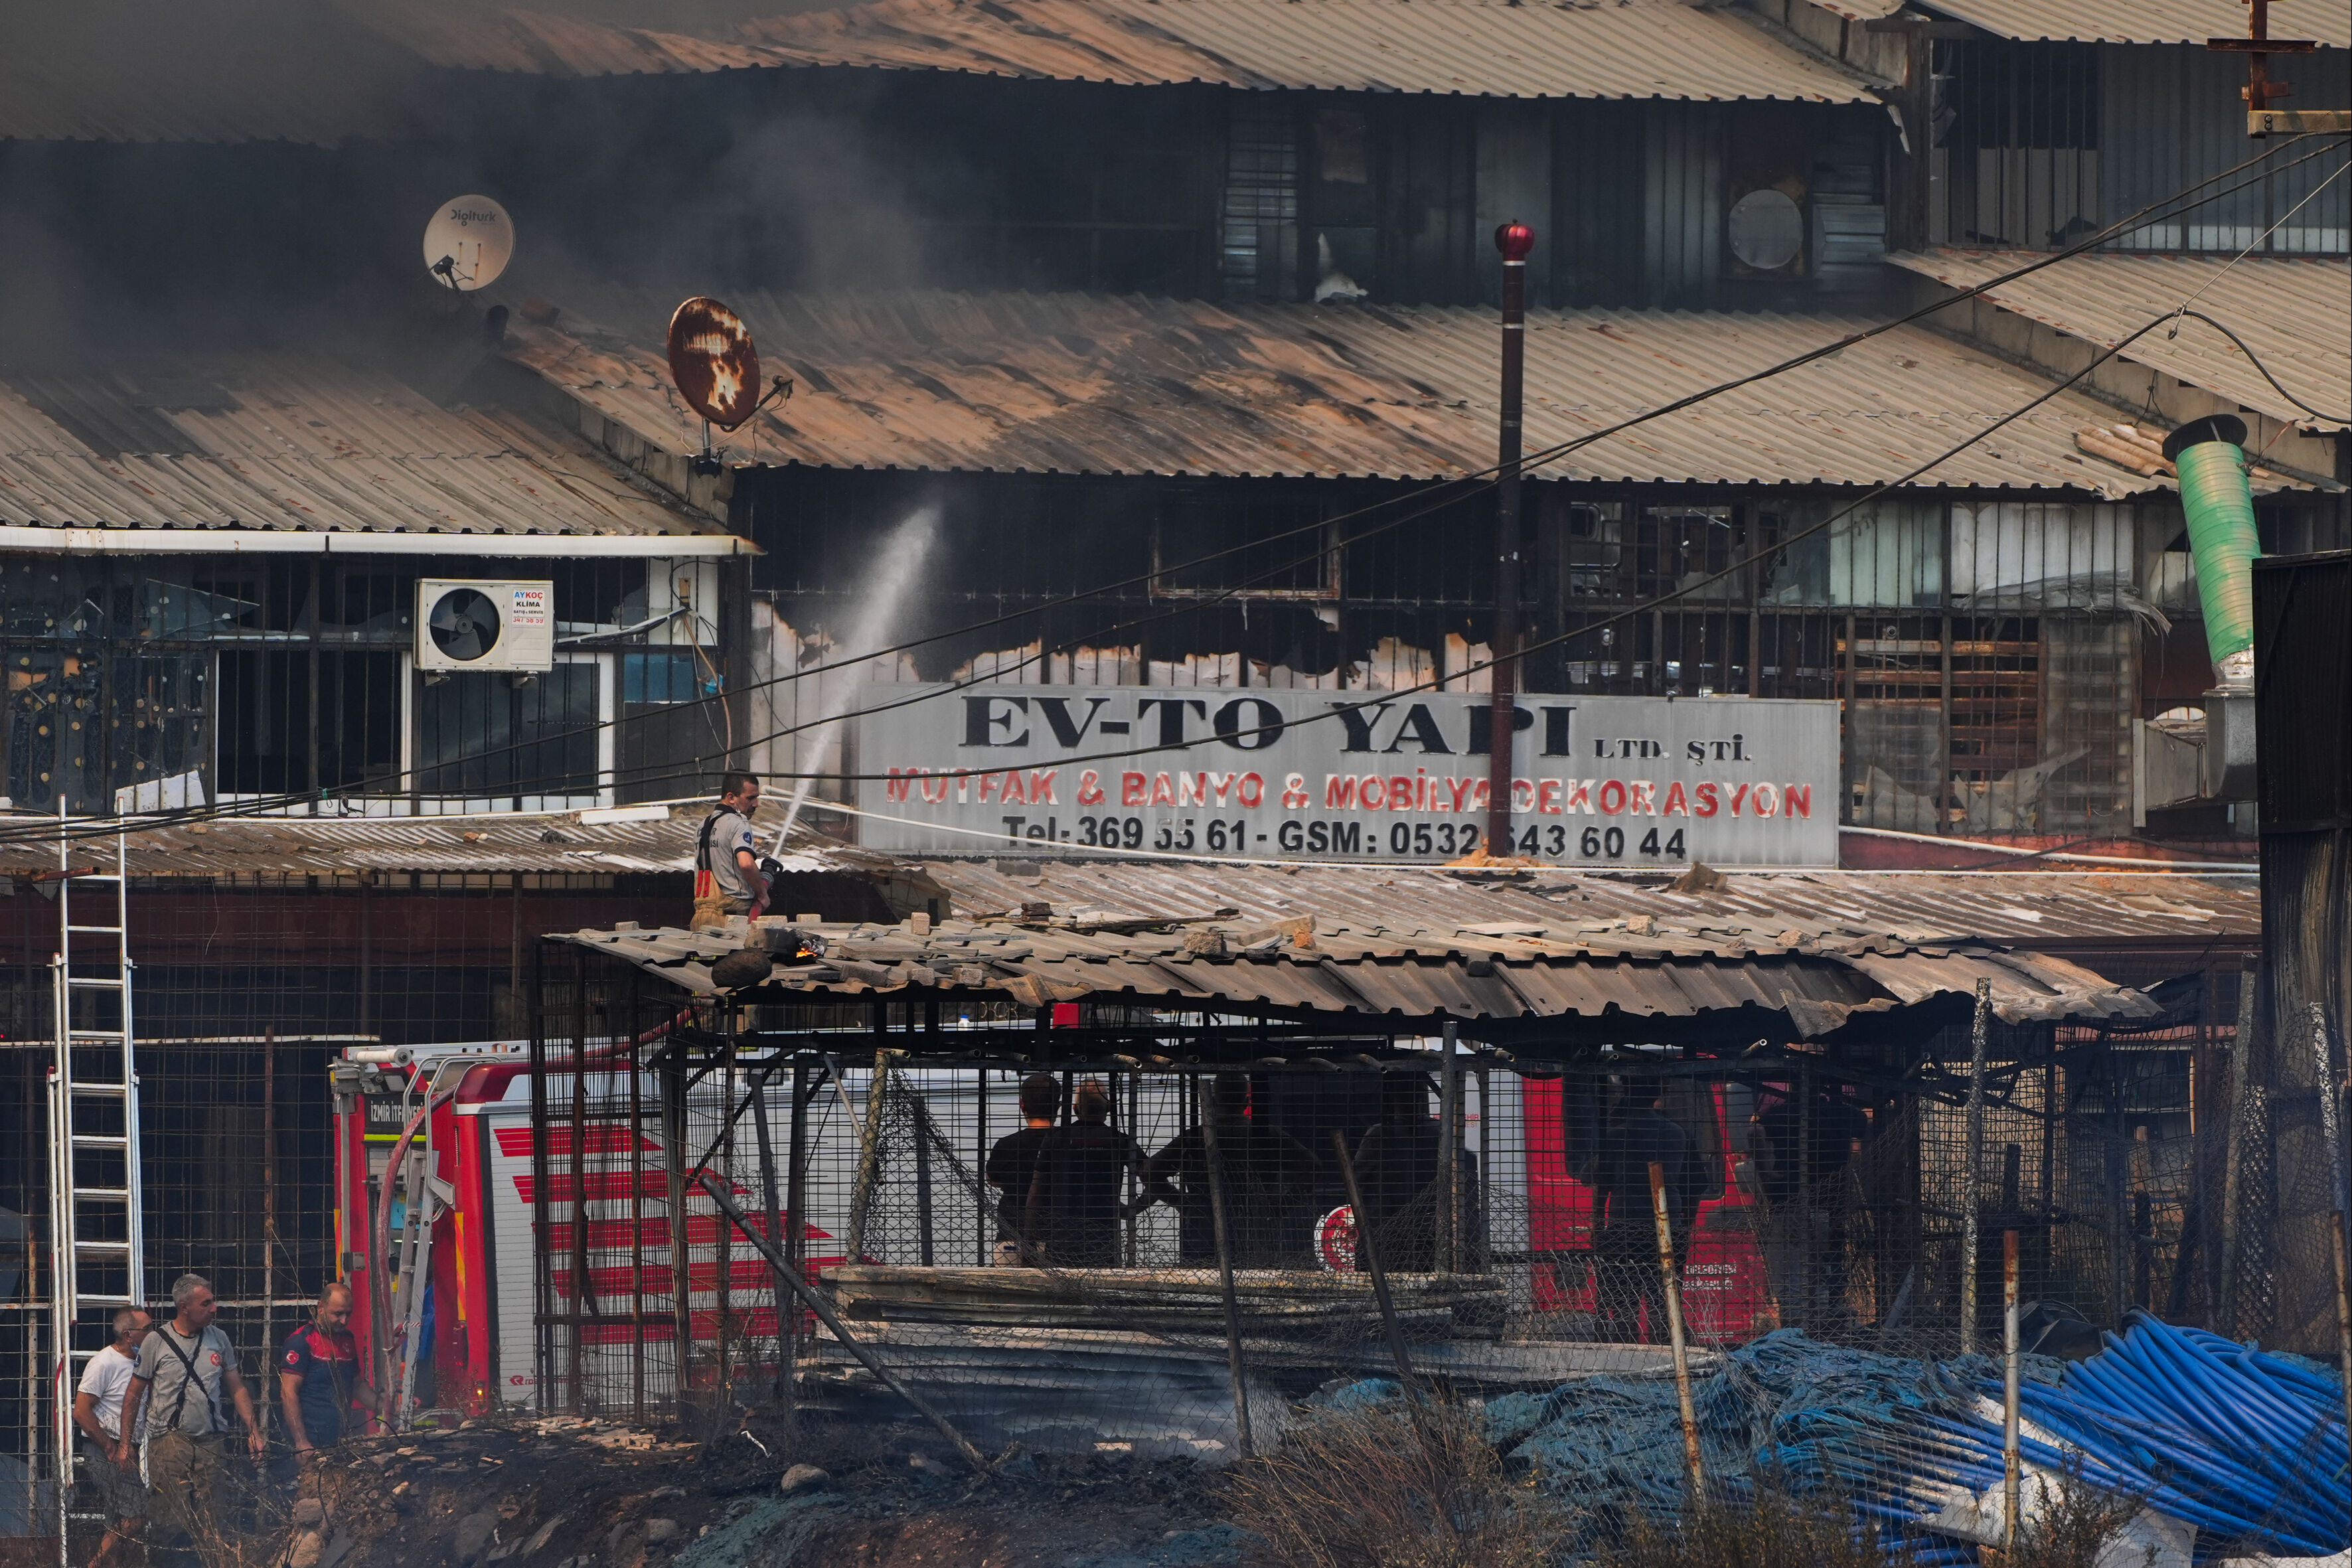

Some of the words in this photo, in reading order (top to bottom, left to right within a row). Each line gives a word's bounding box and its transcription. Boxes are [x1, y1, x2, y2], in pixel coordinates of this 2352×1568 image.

[514, 591, 543, 600] AYKOÇ
[959, 696, 1285, 751] EV-TO
[1324, 702, 1577, 757] YAPI
[1594, 739, 1670, 759] LTD.
[1687, 734, 1753, 765] ŞTİ.
[887, 767, 1059, 805] MUTFAK
[1077, 769, 1106, 805] &
[1123, 771, 1265, 808] BANYO
[1282, 773, 1310, 809] &
[1325, 767, 1491, 813] MOBİLYA
[1511, 778, 1811, 819] DEKORASYON
[1002, 817, 1071, 847] Tel:
[1077, 817, 1143, 848] 369
[1154, 818, 1195, 850] 55
[1207, 819, 1245, 851] 61
[1279, 820, 1377, 853] GSM:
[1390, 822, 1479, 854] 0532
[1581, 826, 1624, 858] 60
[1639, 827, 1686, 859] 44
[370, 1100, 390, 1122] İZMİR
